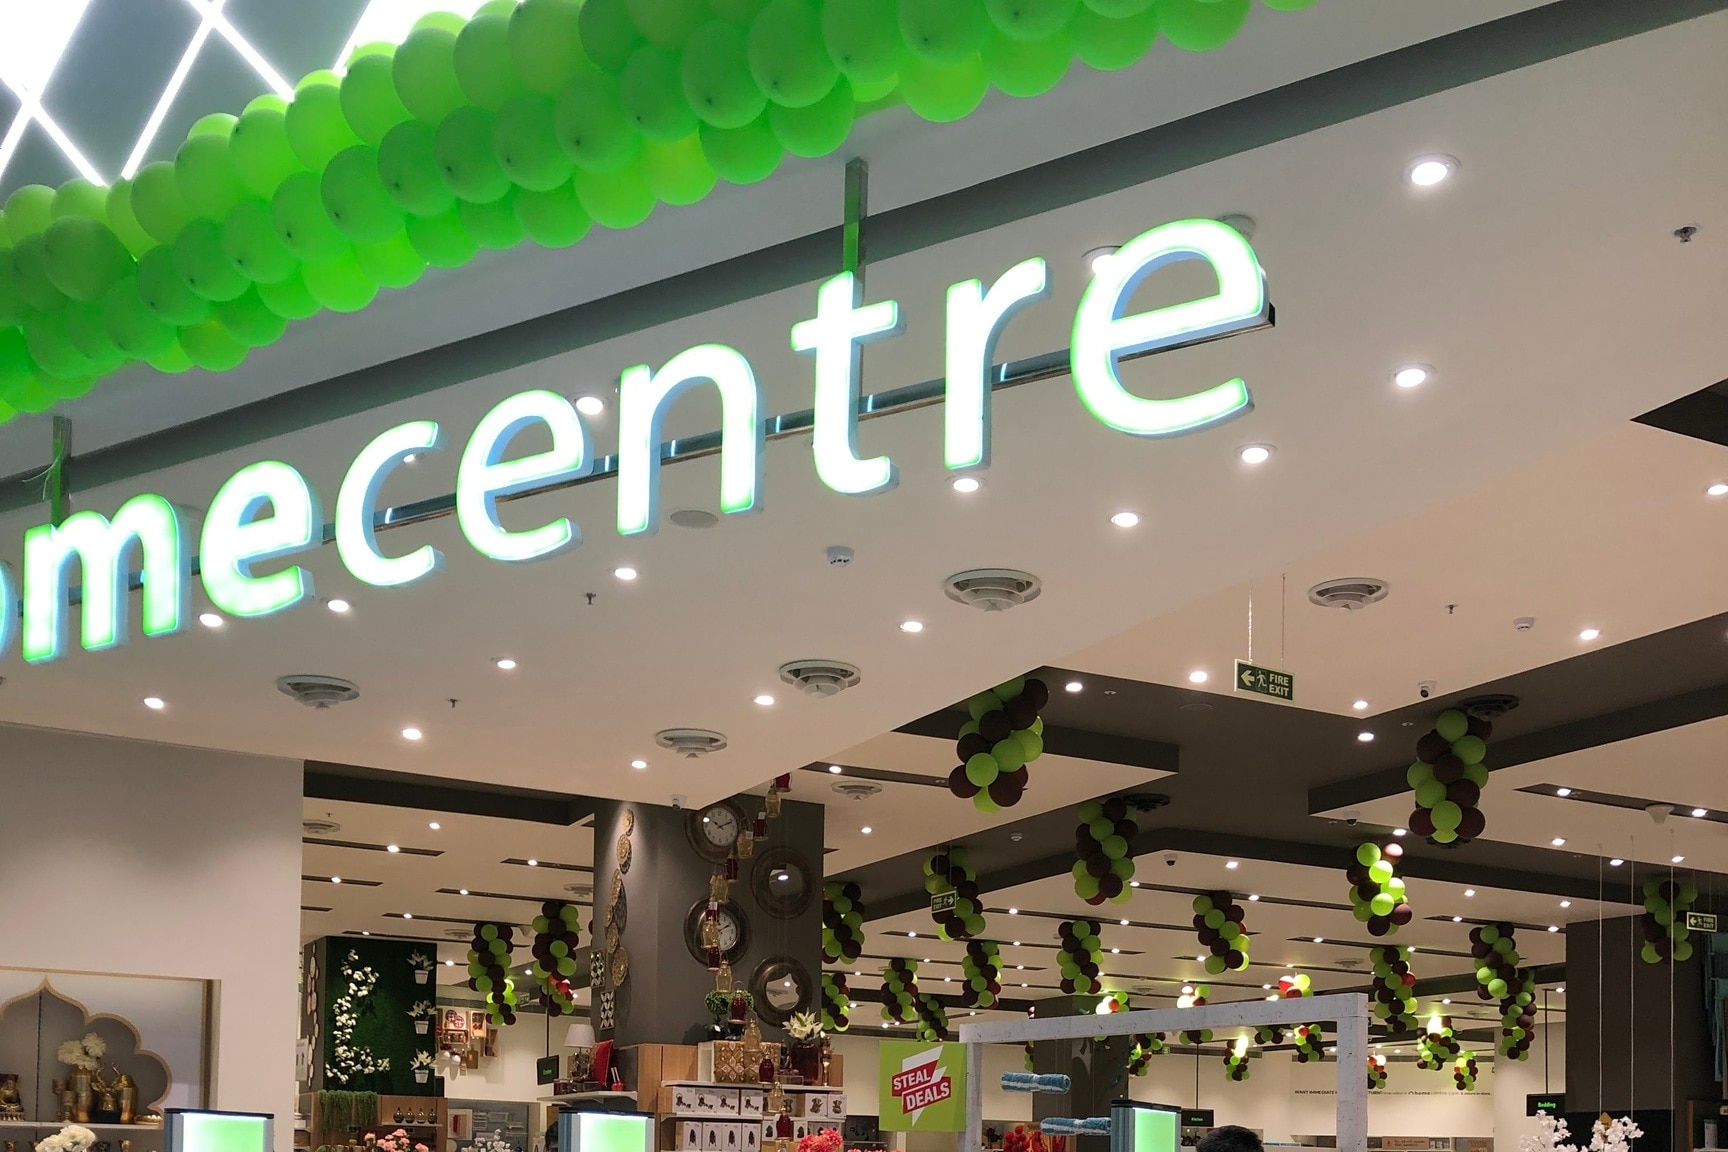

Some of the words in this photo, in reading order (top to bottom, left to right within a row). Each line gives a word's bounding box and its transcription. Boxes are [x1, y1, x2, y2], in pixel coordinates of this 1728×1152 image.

[0, 217, 1270, 664] mecentre
[1269, 673, 1290, 686] FIRE
[1269, 684, 1290, 697] EXIT
[893, 1069, 931, 1091] STEAL
[905, 1082, 950, 1110] DEALS
